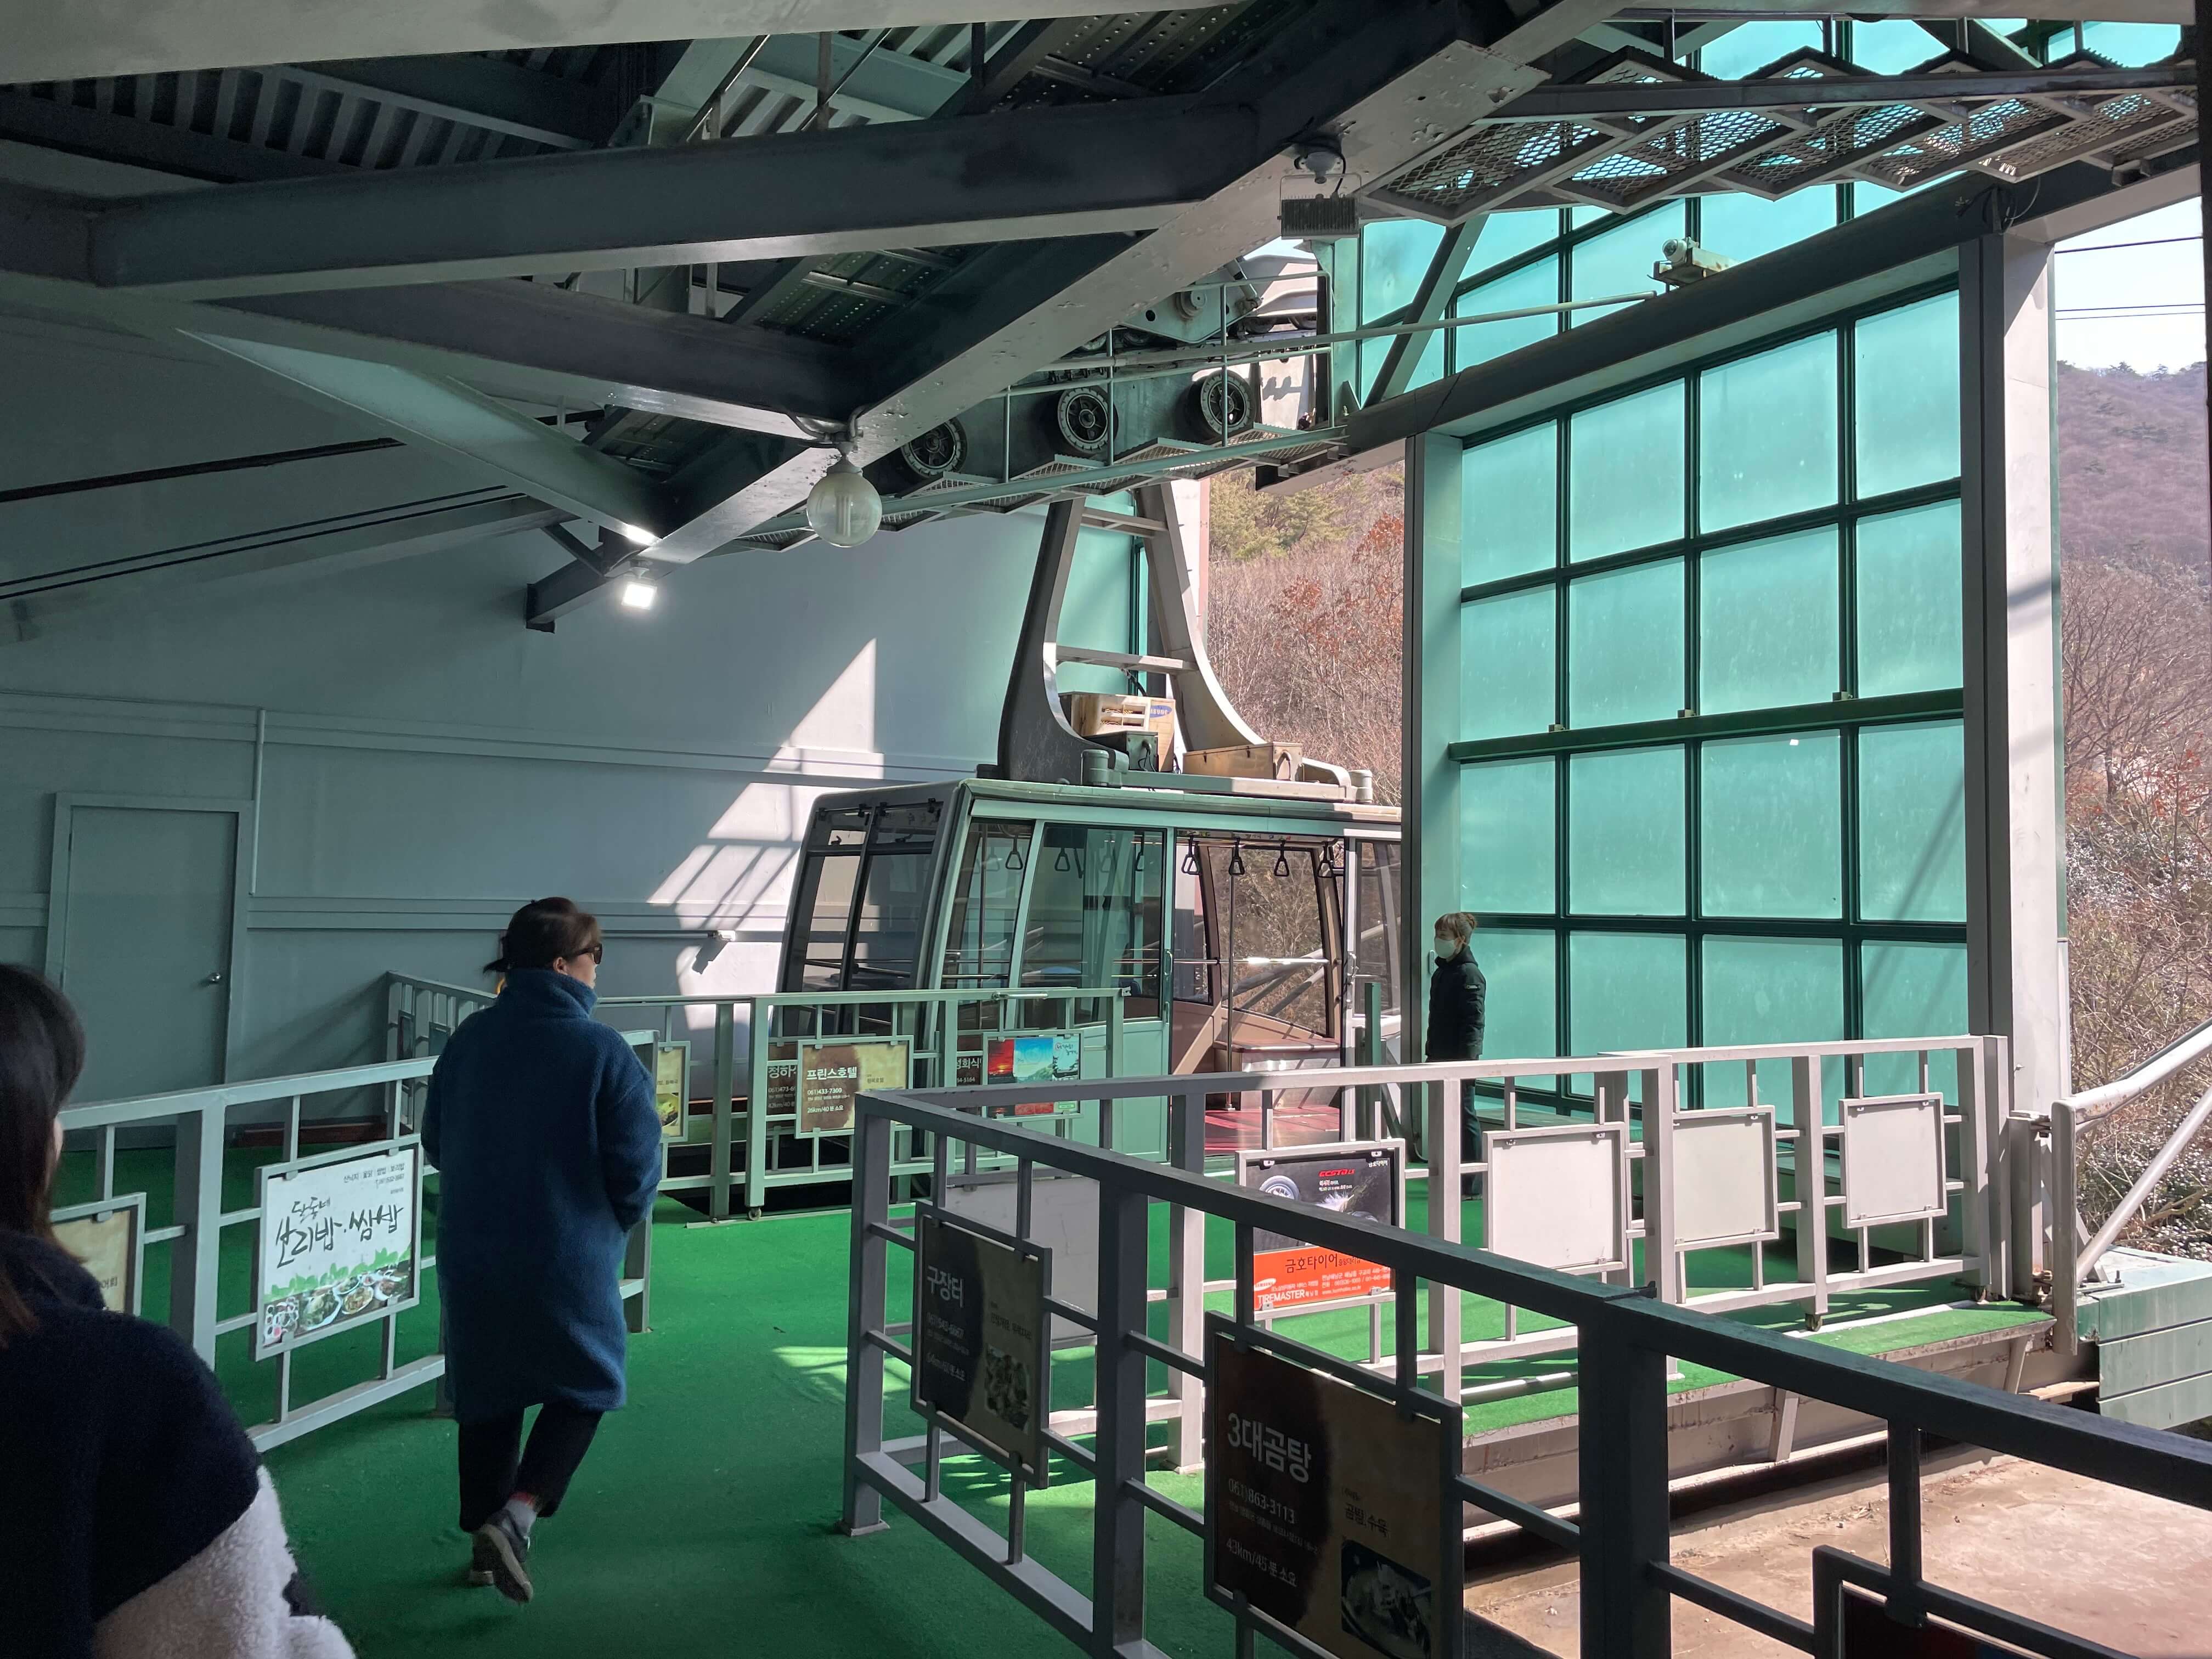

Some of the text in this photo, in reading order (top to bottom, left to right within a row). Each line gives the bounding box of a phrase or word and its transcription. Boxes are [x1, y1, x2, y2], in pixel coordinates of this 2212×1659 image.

[806, 1066, 857, 1080] 프린스호텔
[1285, 1253, 1338, 1273] 금호타이어
[927, 1265, 964, 1308] 구장터
[1227, 1412, 1312, 1483] 3대곰탕
